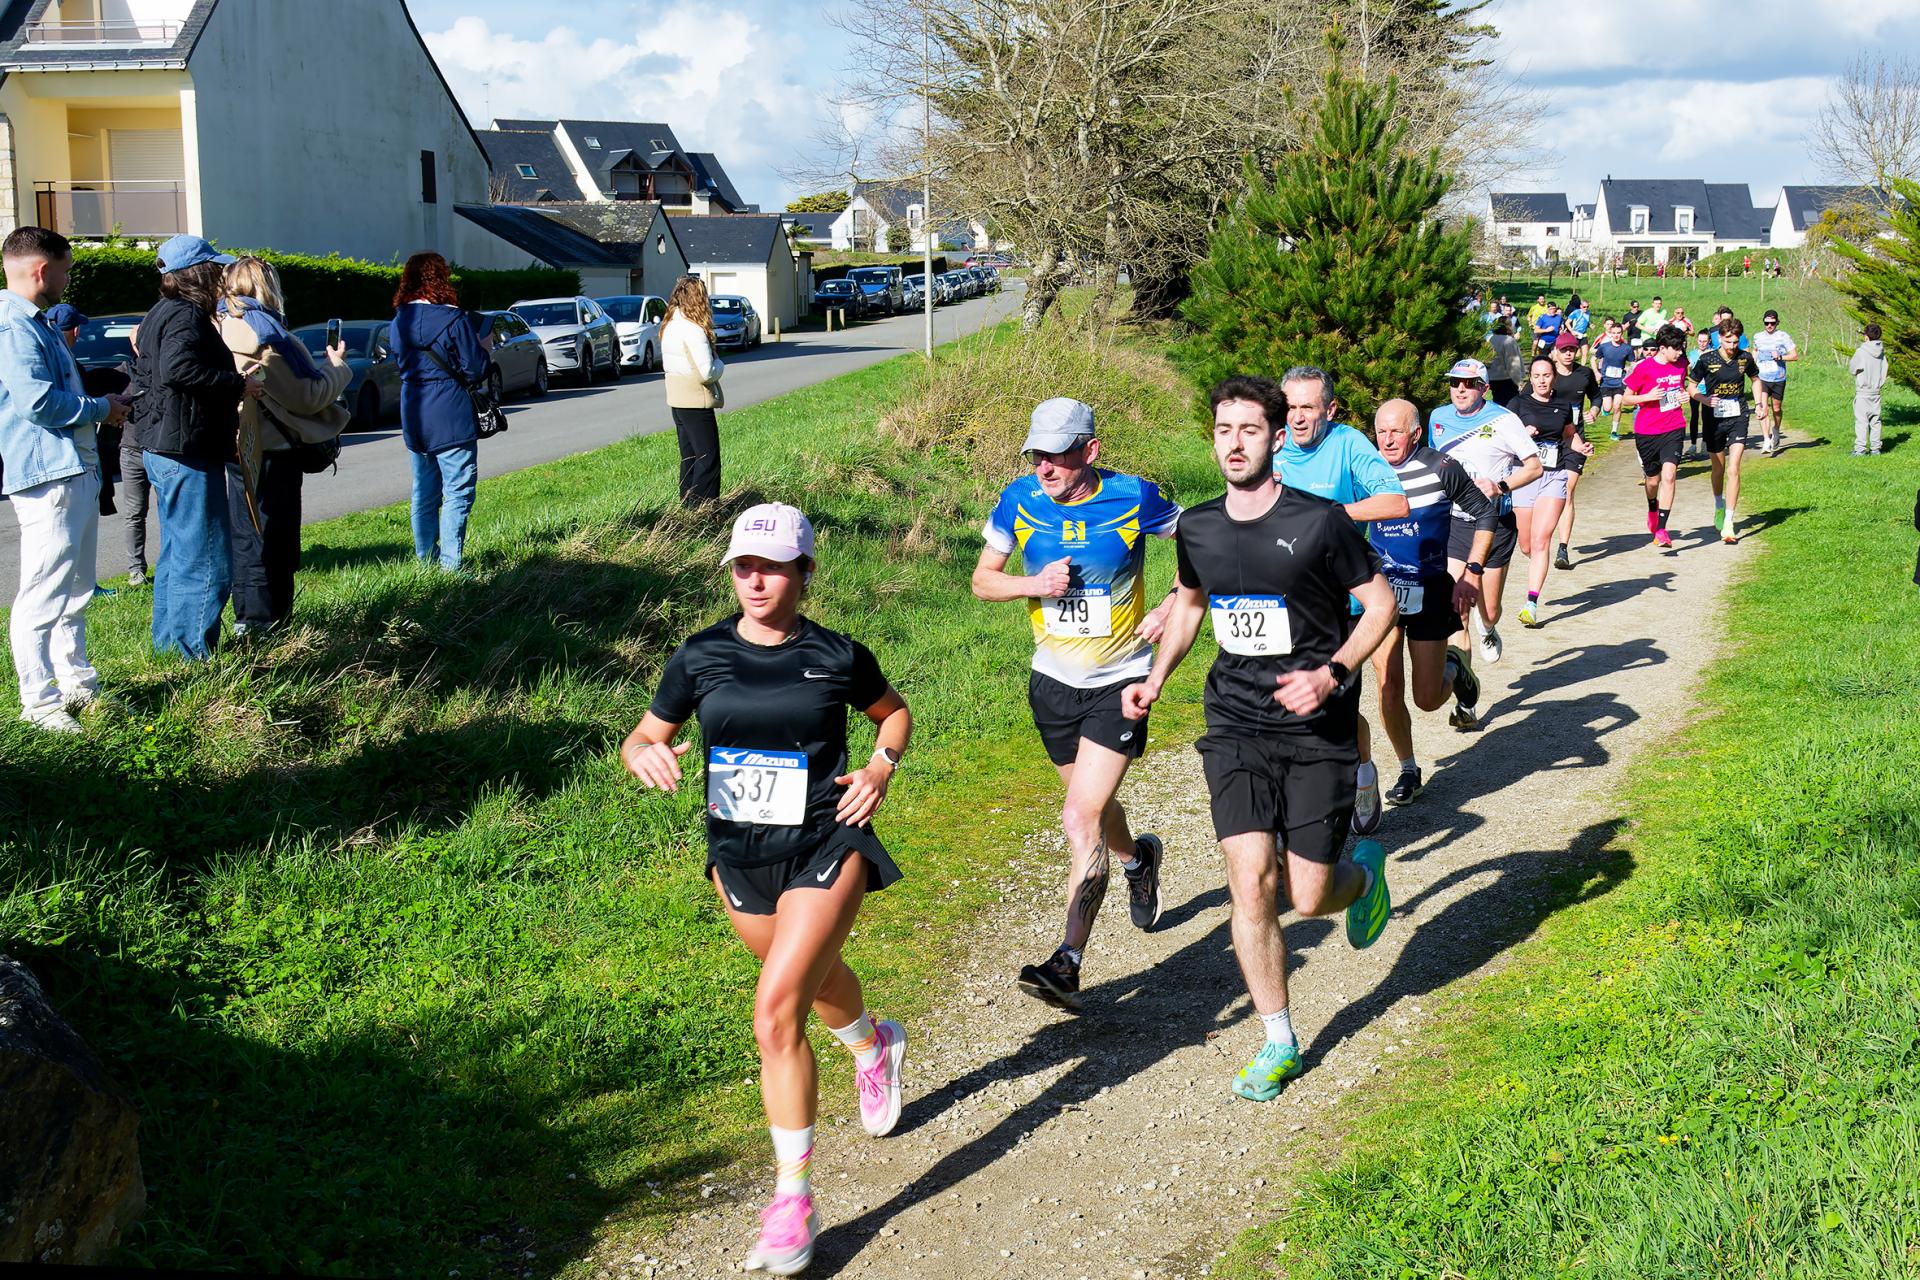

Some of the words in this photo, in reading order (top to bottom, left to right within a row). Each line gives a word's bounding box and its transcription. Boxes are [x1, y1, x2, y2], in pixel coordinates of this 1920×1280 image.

[744, 519, 776, 532] LSU
[1392, 586, 1410, 604] 07
[1057, 599, 1089, 622] 219
[1228, 611, 1266, 638] 332
[732, 768, 778, 803] 337
